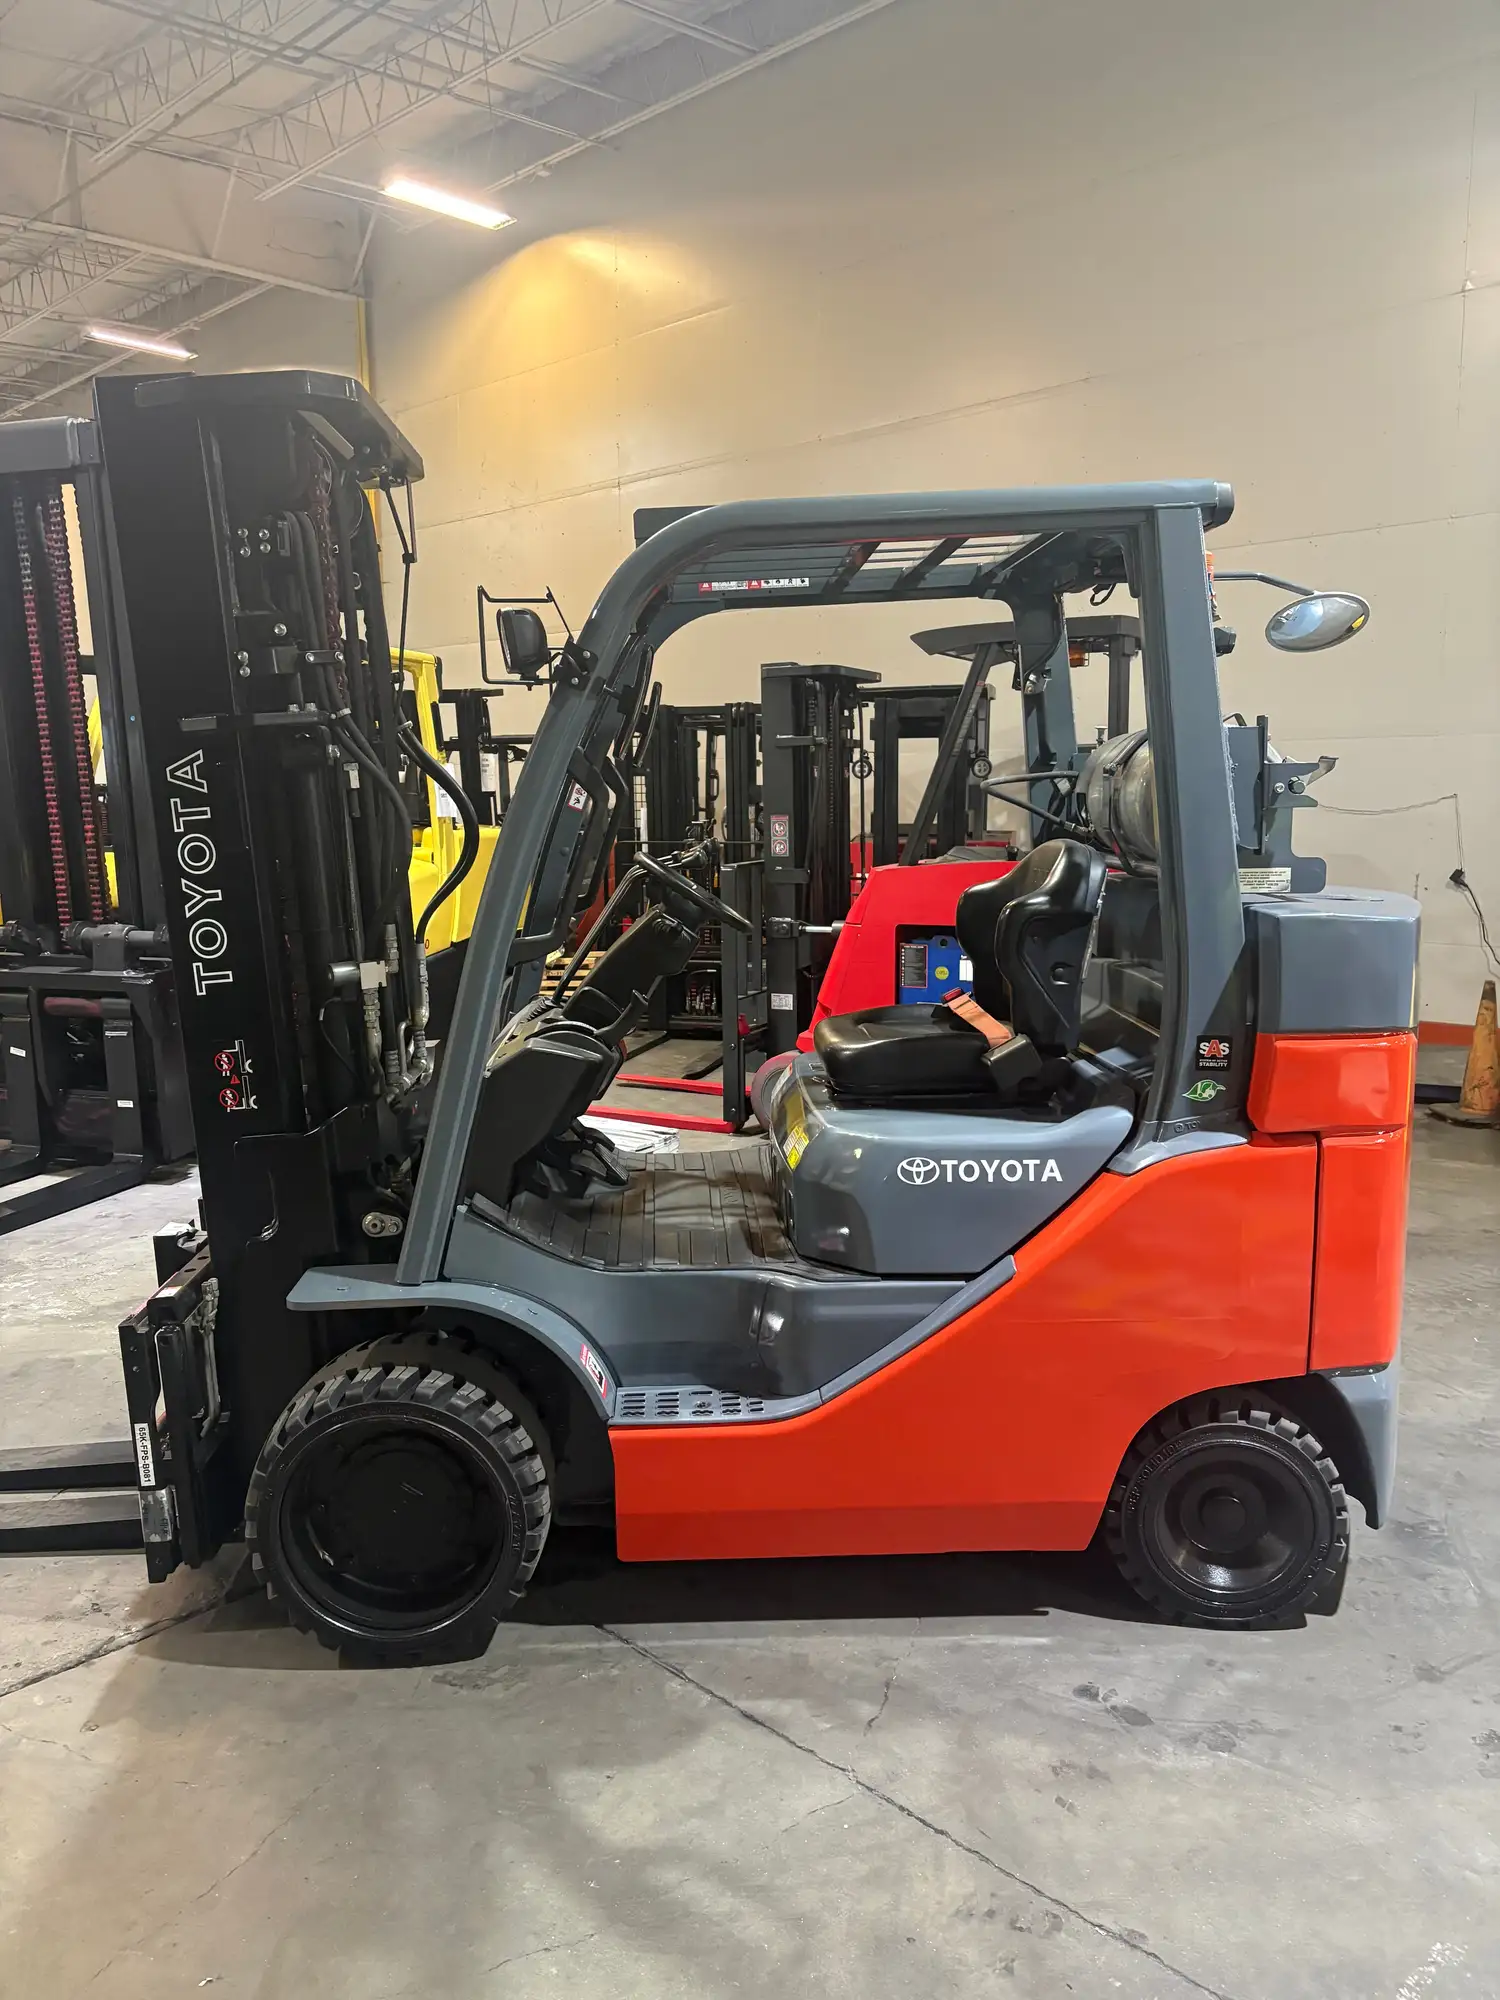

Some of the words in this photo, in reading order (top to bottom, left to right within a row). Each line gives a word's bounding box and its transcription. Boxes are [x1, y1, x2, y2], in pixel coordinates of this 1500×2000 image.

[166, 748, 233, 996] TOYOTA
[1198, 1039, 1230, 1058] SAS
[941, 1158, 1063, 1183] TOYOTA
[138, 1427, 152, 1483] 65K-FPS-B081
